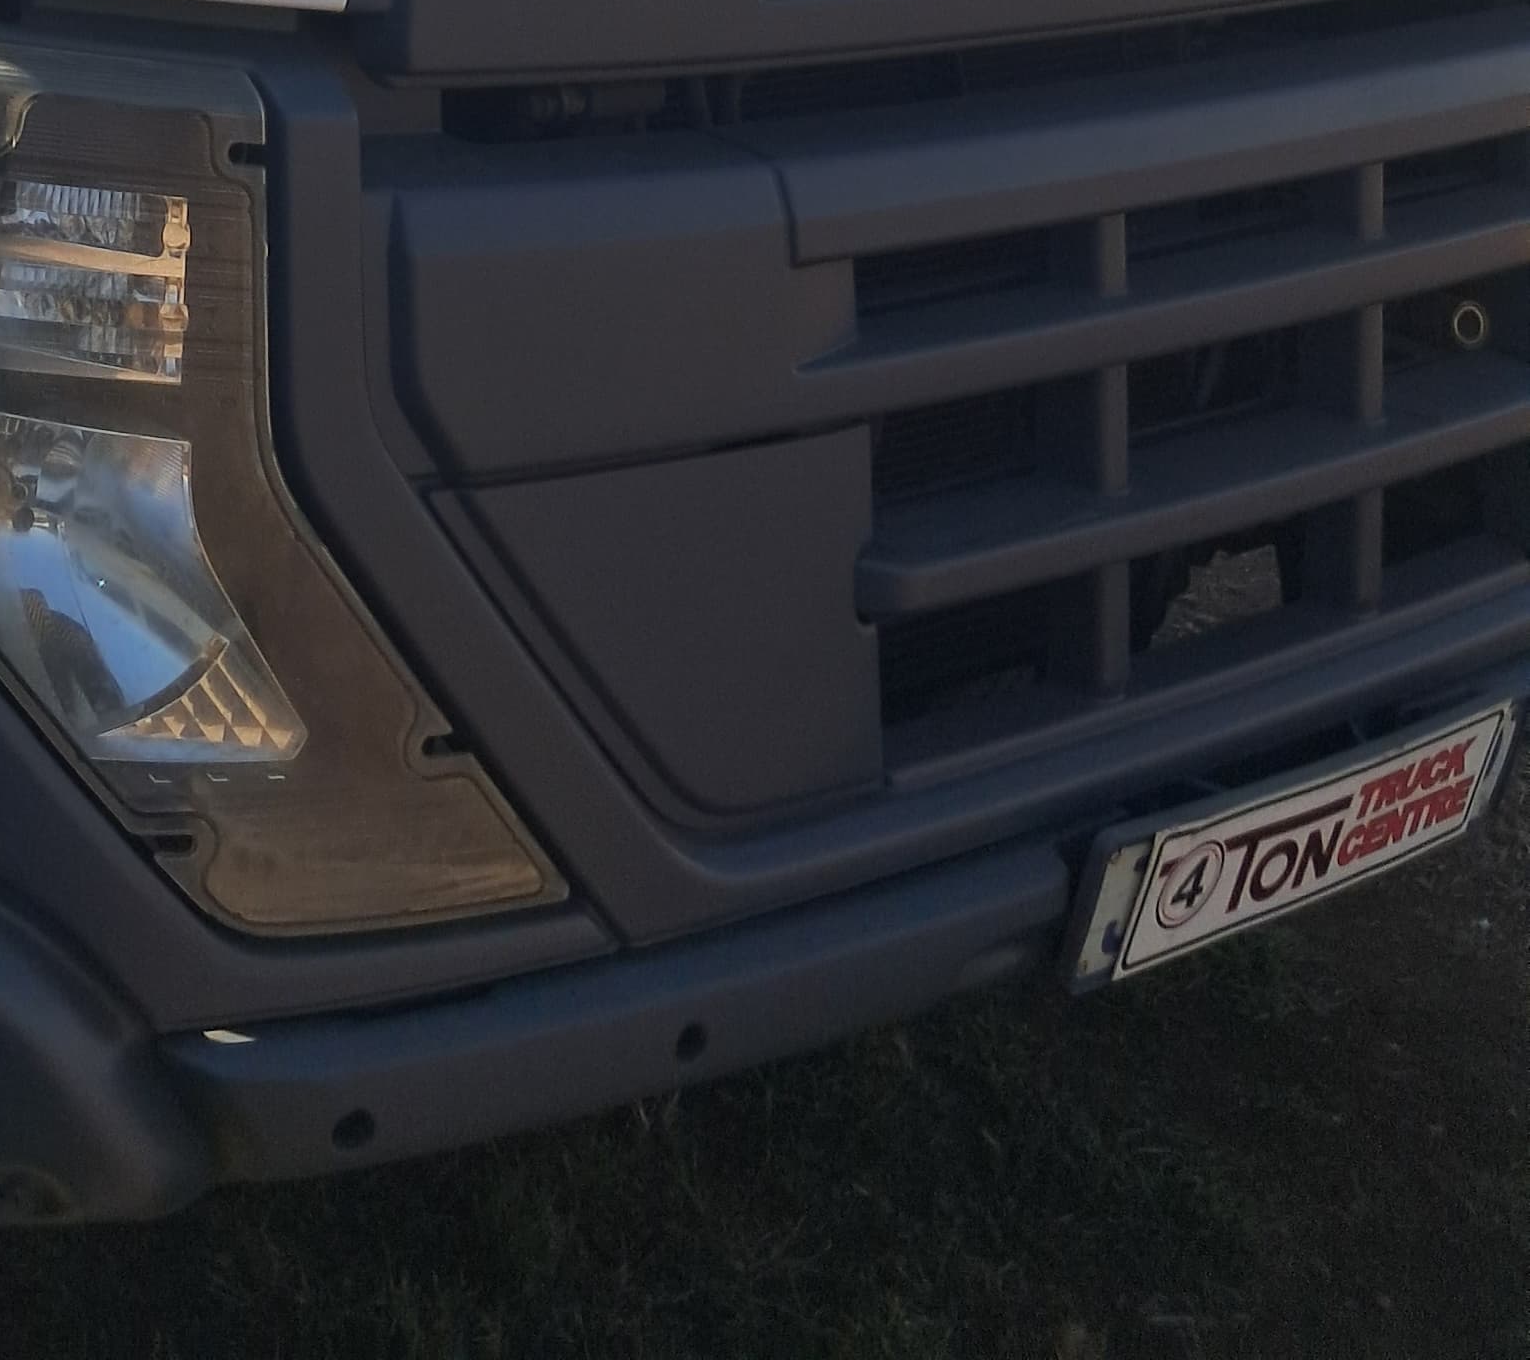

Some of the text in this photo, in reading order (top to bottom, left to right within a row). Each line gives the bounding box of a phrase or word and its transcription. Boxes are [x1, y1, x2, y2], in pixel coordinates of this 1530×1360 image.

[1336, 777, 1476, 868] CENTRE
[1356, 736, 1478, 820] TRUCK
[1225, 794, 1354, 914] TON
